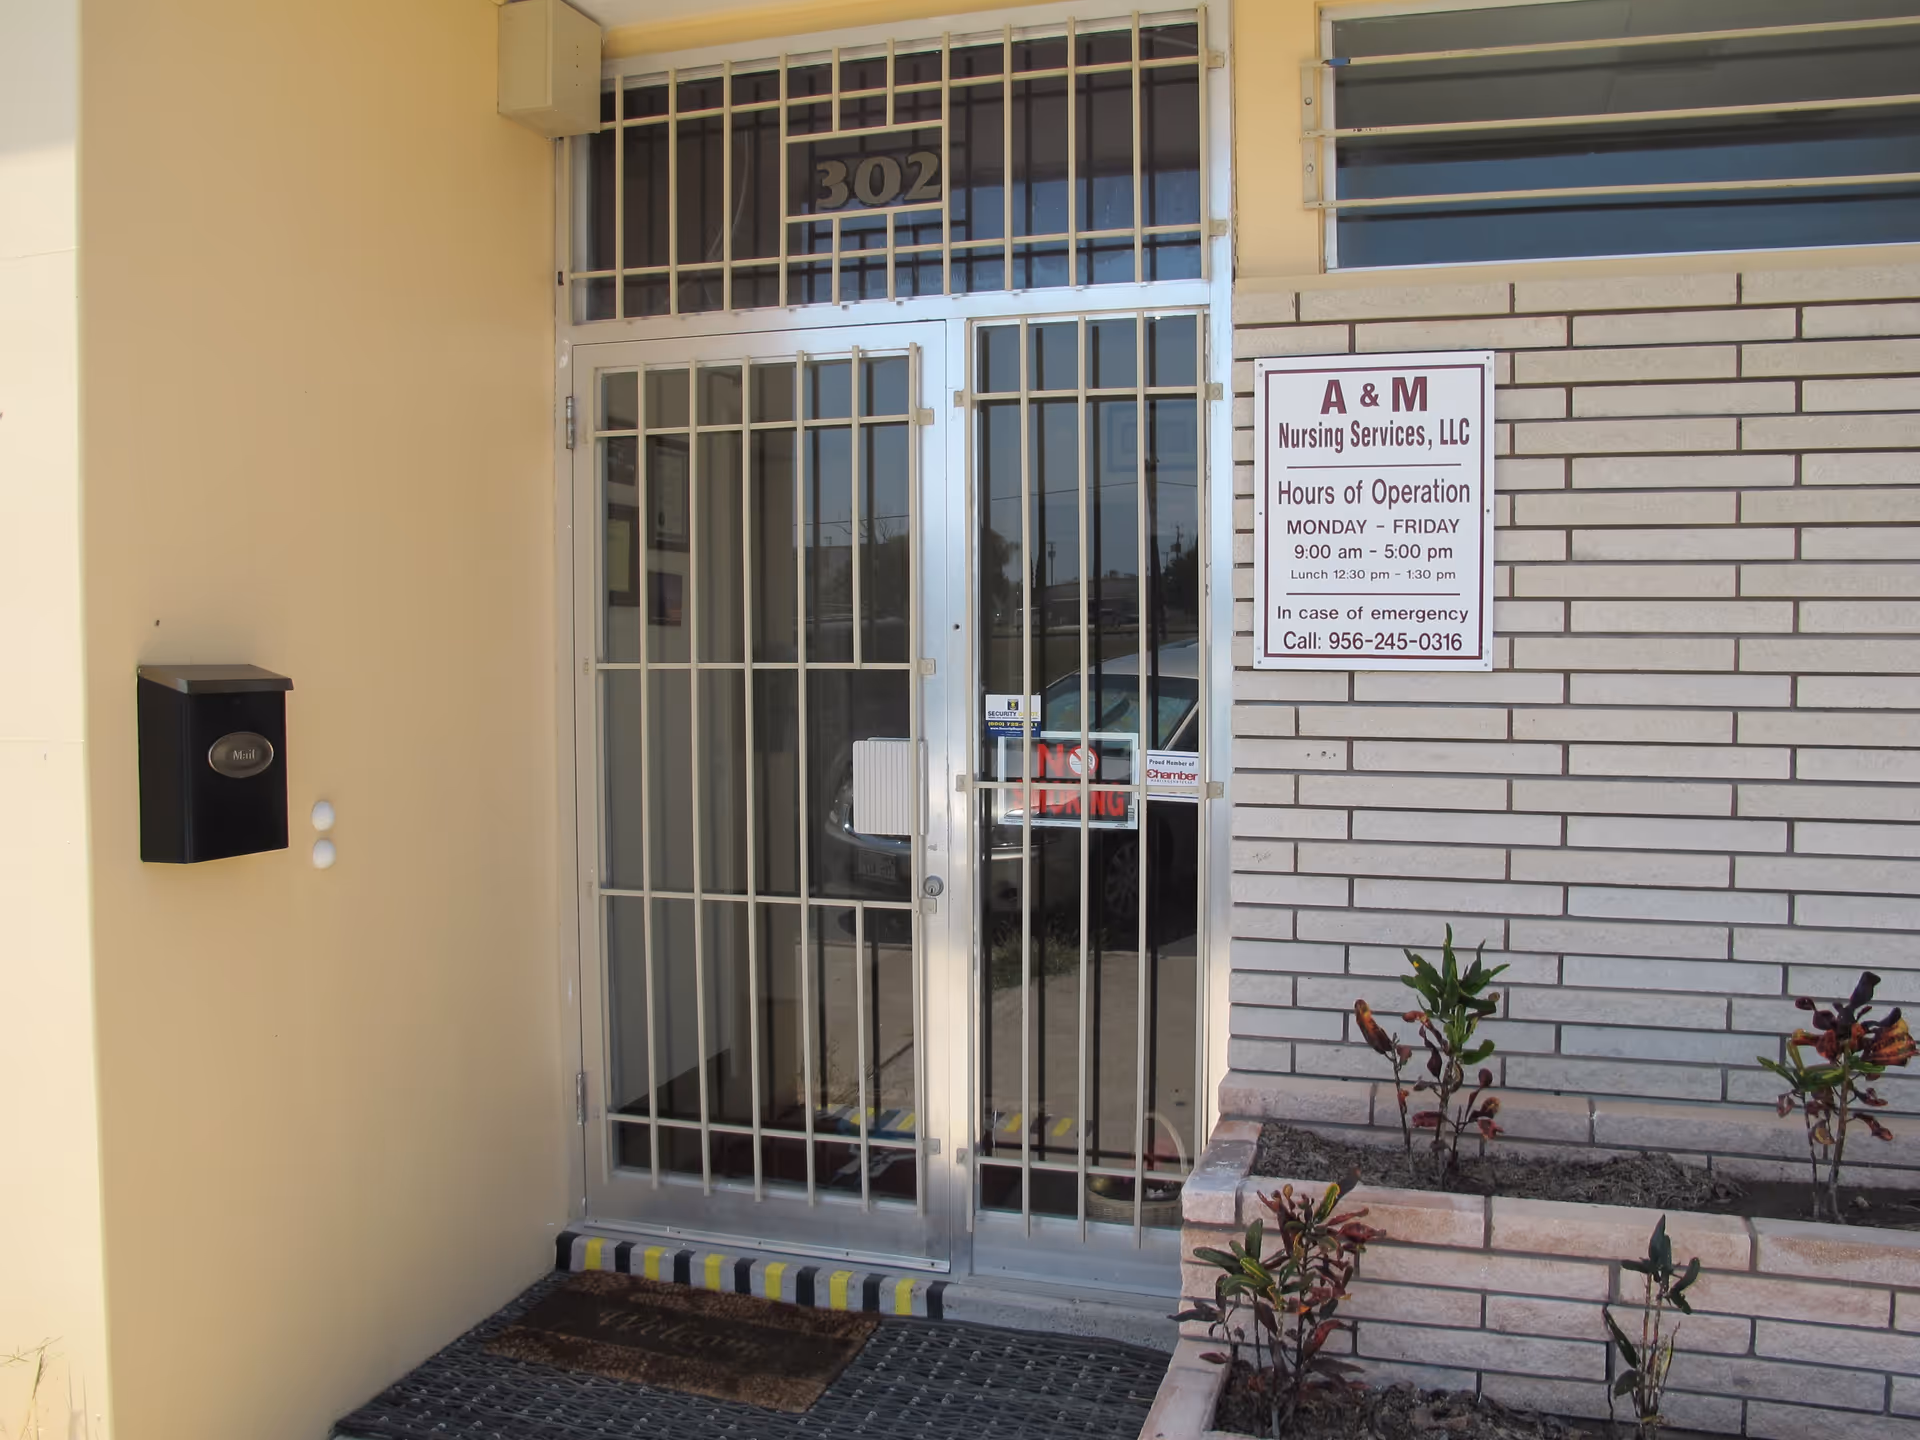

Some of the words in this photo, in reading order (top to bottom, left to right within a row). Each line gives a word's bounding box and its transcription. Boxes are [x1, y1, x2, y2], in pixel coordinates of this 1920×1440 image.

[815, 151, 942, 209] 302
[1319, 378, 1348, 415] A
[1359, 382, 1380, 408] &
[1391, 375, 1428, 413] M
[1278, 421, 1344, 454] Nursing
[1350, 419, 1433, 451] Services,
[1439, 417, 1470, 446] LLC
[1278, 480, 1335, 506] Hours
[1343, 479, 1364, 505] of
[1371, 478, 1470, 510] Operation
[1286, 519, 1368, 536] MONDAY
[1393, 518, 1460, 534] FRIDAY
[1294, 544, 1332, 560] 9:00
[1337, 547, 1363, 560] am
[1384, 543, 1421, 559] 5:00
[1427, 546, 1453, 563] pm
[1290, 569, 1329, 580] Lunch
[1333, 569, 1366, 580] 12:30
[1370, 571, 1390, 582] pm
[1406, 569, 1432, 580] 1:30
[1436, 571, 1456, 582] pm
[1277, 605, 1292, 620] In
[1298, 608, 1339, 620] case
[1346, 605, 1364, 620] of
[1370, 608, 1469, 624] emergency
[1283, 630, 1322, 650] Call:
[1328, 631, 1463, 652] 956-245-0316
[233, 749, 256, 760] Mail
[1147, 769, 1198, 781] Chamber
